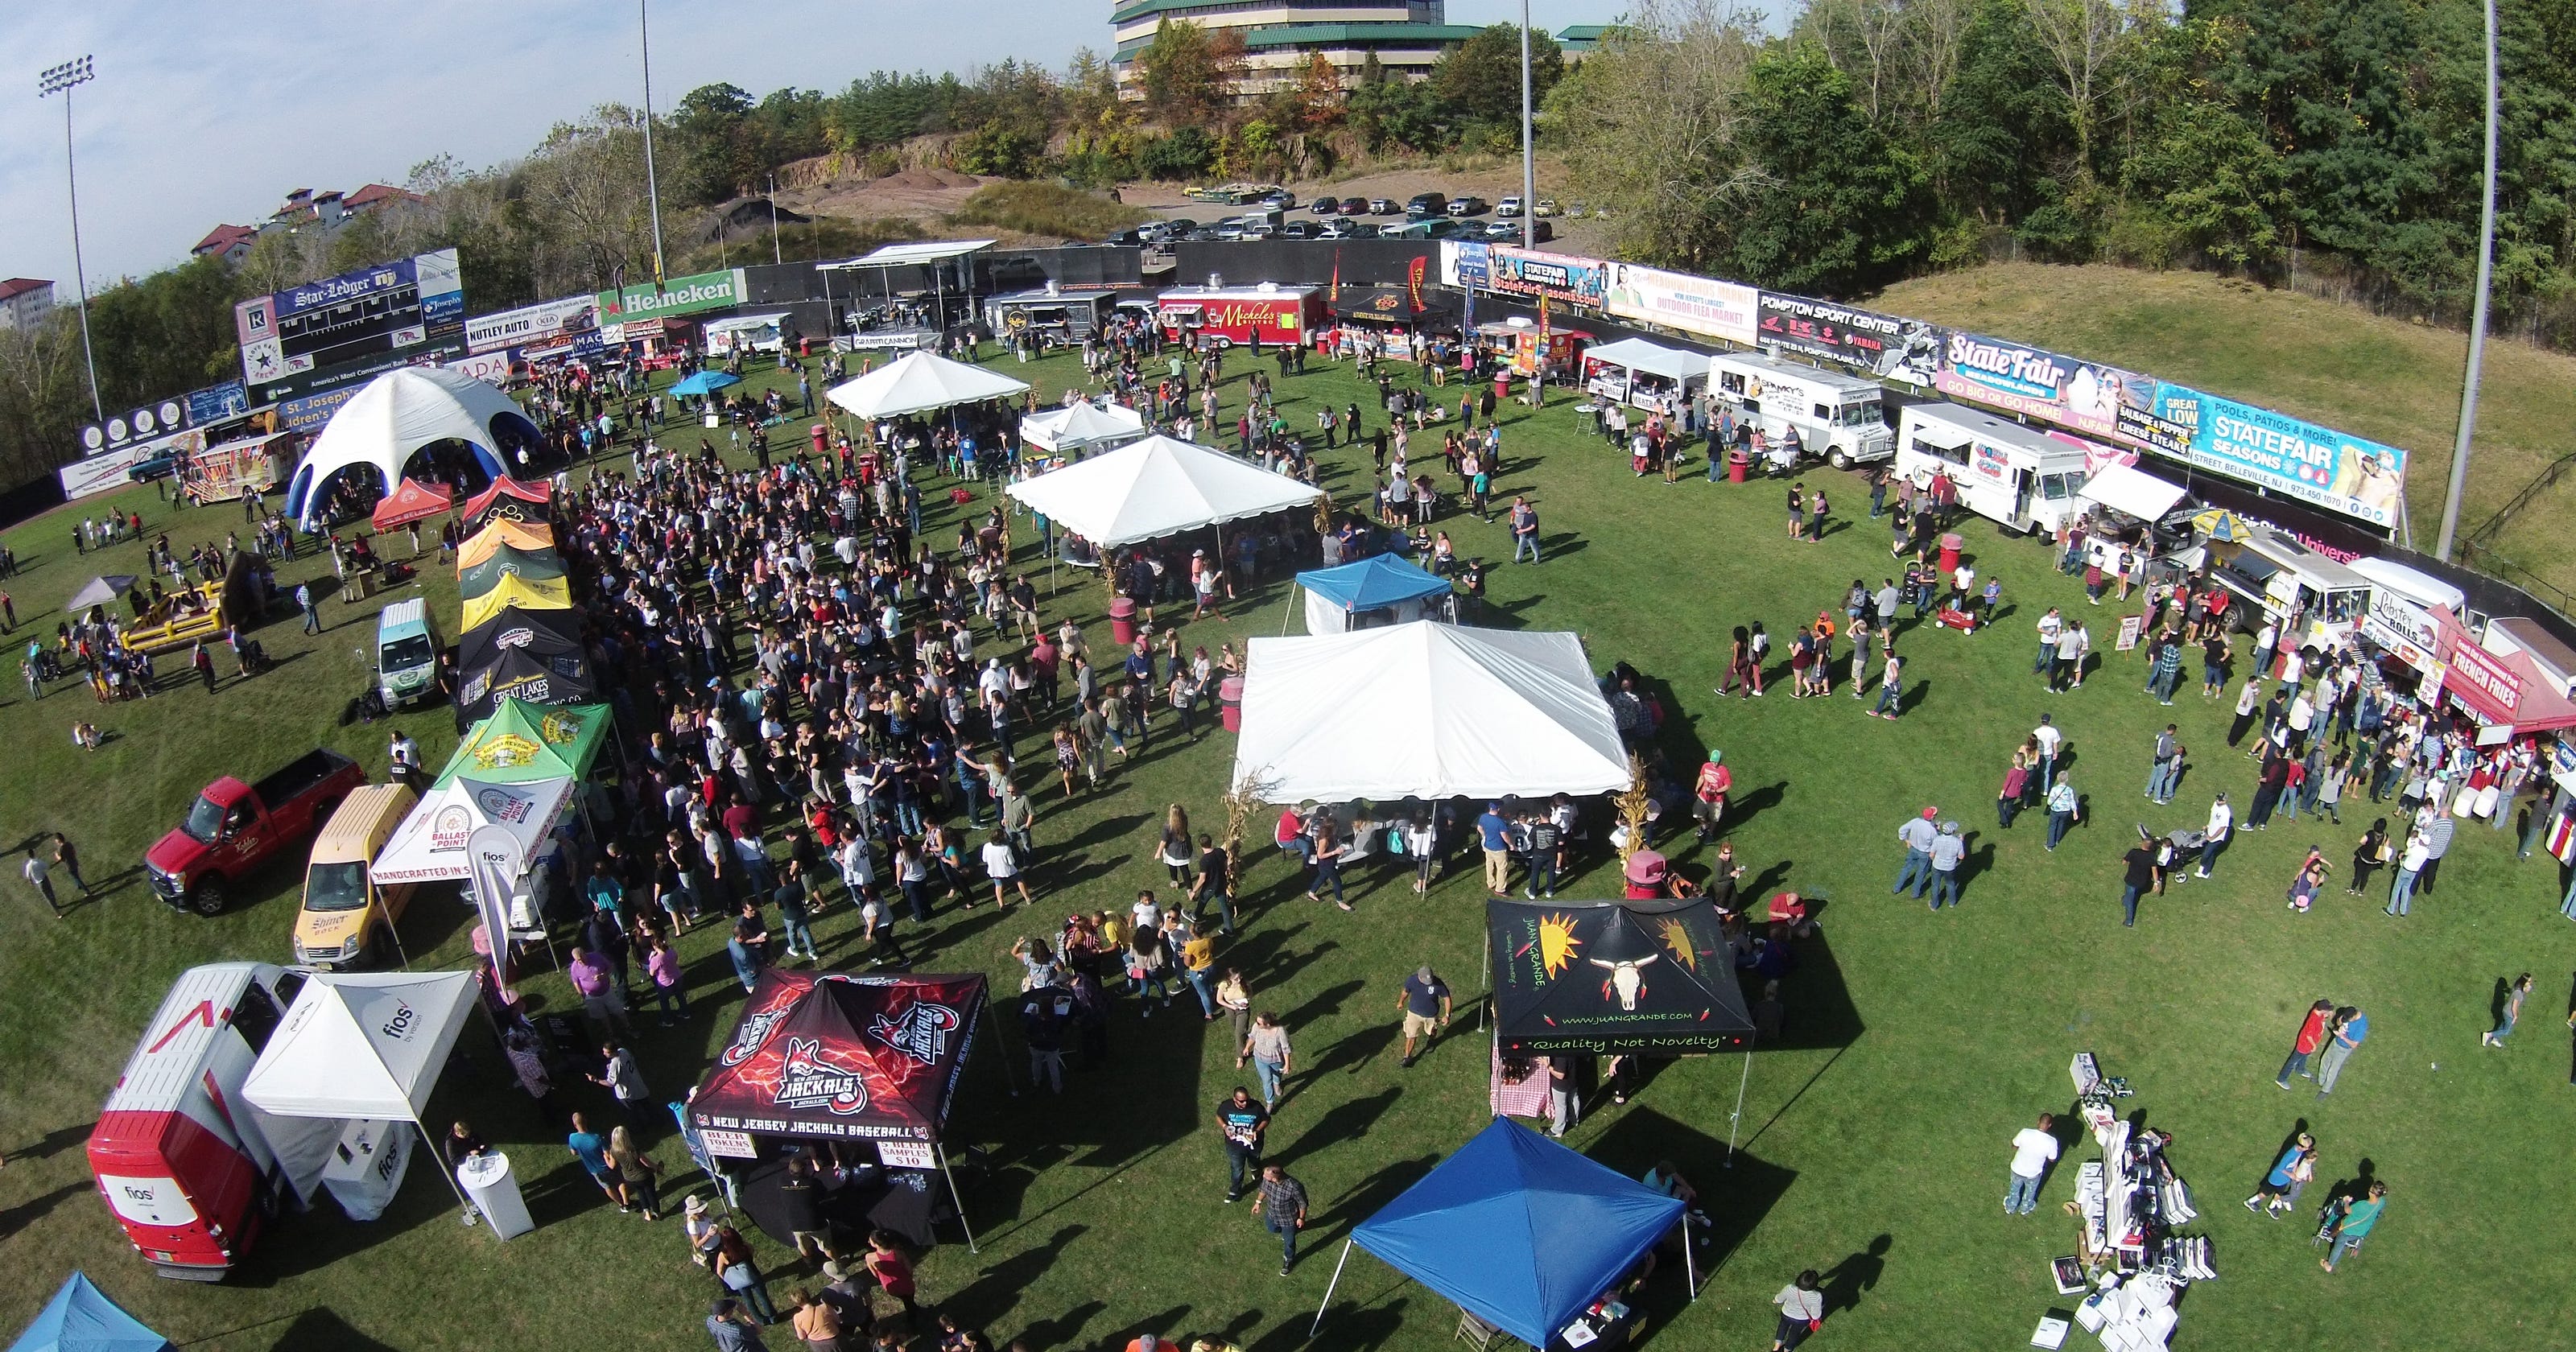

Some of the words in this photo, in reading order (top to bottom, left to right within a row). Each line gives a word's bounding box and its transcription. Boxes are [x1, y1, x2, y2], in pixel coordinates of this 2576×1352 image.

[1524, 262, 1567, 278] STATEFAIR
[1524, 274, 1550, 284] SEASONS
[295, 278, 369, 307] Star-Ledger
[625, 283, 733, 314] Heineken
[1495, 278, 1601, 307] StateFairSasons.com
[1648, 273, 1716, 297] MEADOWLANDS
[1717, 286, 1755, 306] MARKET
[1685, 294, 1705, 304] JERSEY'S
[1705, 297, 1725, 308] LARGEST
[540, 315, 556, 325] KIA
[1657, 297, 1691, 315] OUTDOOR
[1694, 303, 1711, 319] FLEA
[1711, 308, 1744, 325] MARKET
[1761, 295, 1814, 317] POMPTON
[1814, 306, 1853, 325] SPORT
[1853, 315, 1901, 336] CENTER
[470, 325, 503, 342] NUTLEY
[505, 320, 530, 334] AUTO
[885, 336, 917, 345] CANNON
[1761, 324, 1783, 333] HONDA
[1816, 336, 1839, 345] SUZUKI
[1790, 343, 1798, 351] 23
[1804, 346, 1834, 360] POMPTON
[1833, 352, 1856, 365] PLAINS,
[1856, 359, 1865, 367] NJ
[1853, 336, 1882, 352] YAMAHA
[1948, 334, 2010, 375] State
[2011, 348, 2066, 388] Fair
[312, 376, 340, 387] America's
[341, 372, 357, 381] Most
[357, 362, 392, 376] Convenient
[1964, 369, 2047, 398] MEADOWLANDS
[287, 404, 303, 414] St.
[307, 389, 359, 410] Joseph's
[1946, 381, 1964, 393] GO
[1966, 385, 1986, 399] BIG
[1988, 393, 2002, 403] OR
[2004, 395, 2022, 410] GO
[2025, 398, 2063, 421] HOME!
[2077, 415, 2113, 435] NJFAIR
[2165, 398, 2198, 410] GREAT
[288, 411, 329, 427] ldren's
[2119, 406, 2153, 427] SAUSAGE
[2153, 421, 2159, 429] &
[2158, 421, 2190, 439] PEPPER
[2166, 410, 2199, 426] LOW
[2215, 402, 2252, 422] POOLS,
[2254, 414, 2290, 432] PATIOS
[2293, 426, 2300, 435] &
[2302, 428, 2337, 447] MORE!
[2118, 421, 2150, 441] CHEESE
[2150, 433, 2187, 455] STEAKS
[2214, 415, 2333, 470] STATEFAIR
[2212, 439, 2282, 471] SEASONS
[2193, 453, 2224, 470] STREET,
[2224, 463, 2271, 486] BELLEVILLE,
[2271, 476, 2283, 488] NJ
[2290, 484, 2342, 508] 973.450.1070
[403, 506, 440, 519] BELGIUM
[2297, 533, 2361, 566] Universit
[2370, 592, 2413, 627] Lobster
[2388, 619, 2418, 643] ROLLS
[2456, 638, 2471, 655] Fresh
[2470, 649, 2479, 661] Cut
[2478, 654, 2508, 682] Amusement
[2505, 674, 2519, 690] Park
[493, 685, 521, 704] GREAT
[522, 679, 549, 697] LAKES
[2453, 650, 2491, 690] FRENCH
[2487, 675, 2516, 709] FRIES
[483, 741, 504, 754] SIERRA
[505, 740, 530, 752] NEVADA
[500, 796, 519, 822] BALLAST
[510, 801, 525, 820] POINT
[527, 825, 549, 863] DEDICATED
[547, 815, 554, 826] TO
[552, 802, 562, 818] THE
[559, 783, 572, 806] CRAFT
[431, 831, 472, 842] BALLAST
[436, 839, 465, 851] POINT
[483, 851, 505, 862] fios
[375, 868, 448, 880] HANDCRAFTED
[451, 867, 461, 876] IN
[1522, 917, 1537, 942] JUAN
[1527, 947, 1546, 987] GRANDE
[382, 1008, 413, 1039] fios
[1562, 1013, 1693, 1025] WWW.JUANGRANDE.COM
[915, 1007, 934, 1060] JACKALS
[1528, 1038, 1606, 1053] "Quality
[1614, 1039, 1646, 1048] Not
[1652, 1036, 1727, 1049] Novelty"
[782, 1078, 854, 1098] JACKALS
[708, 1131, 745, 1140] BEER
[713, 1116, 740, 1129] NEW
[742, 1119, 788, 1131] JERSEY
[791, 1122, 845, 1136] JACKALS
[848, 1124, 913, 1138] BASEBALL
[708, 1139, 750, 1148] TOKENS
[884, 1148, 929, 1157] SAMPLES
[378, 1144, 397, 1181] fios
[896, 1156, 920, 1166] $10
[125, 1185, 153, 1201] fios
